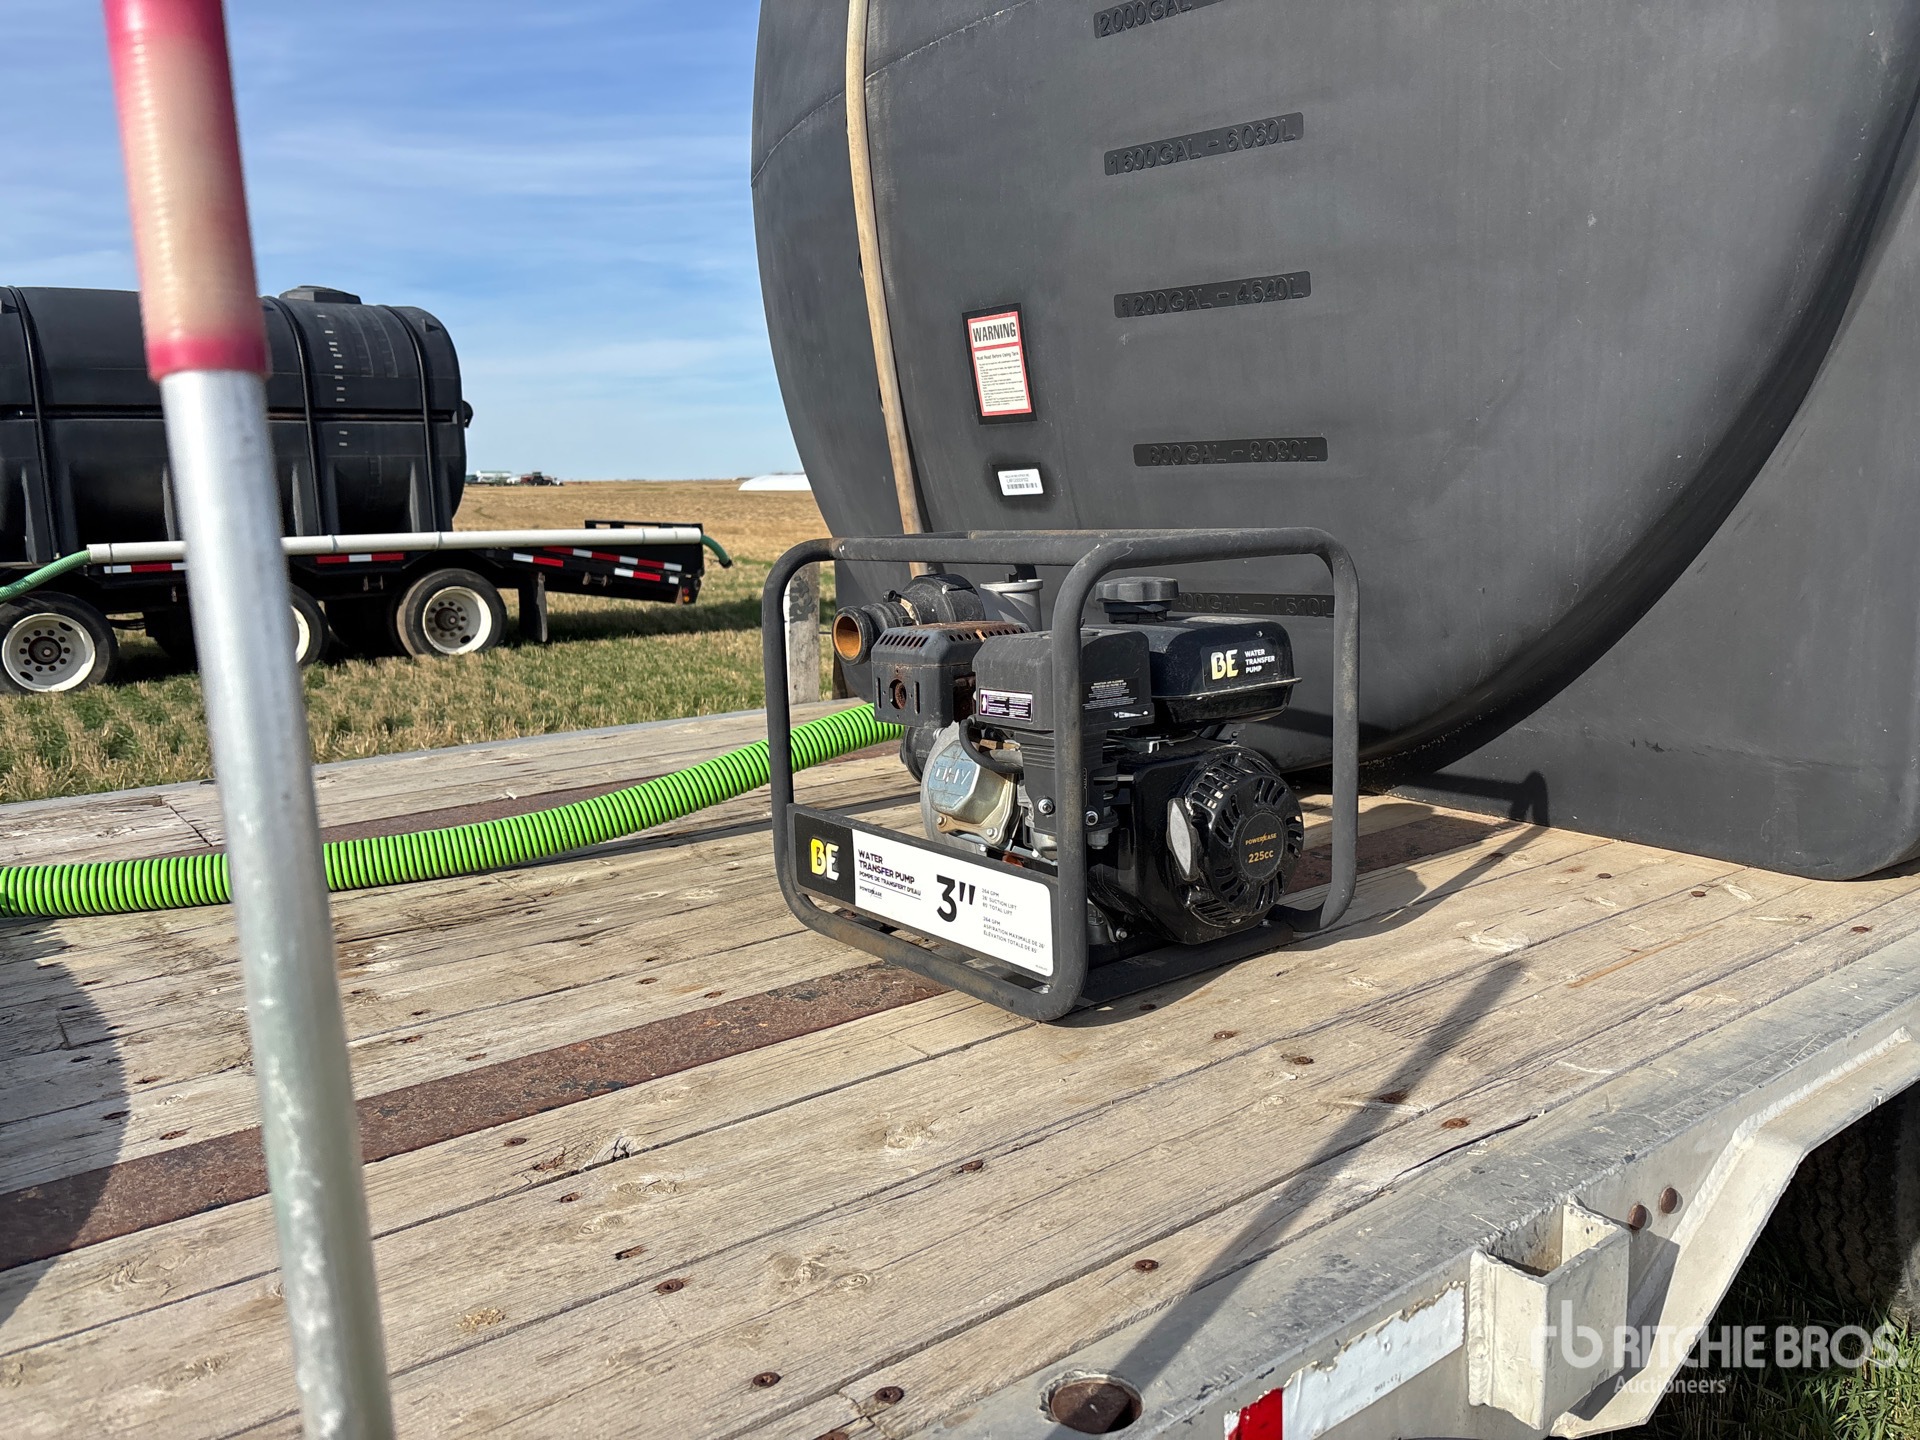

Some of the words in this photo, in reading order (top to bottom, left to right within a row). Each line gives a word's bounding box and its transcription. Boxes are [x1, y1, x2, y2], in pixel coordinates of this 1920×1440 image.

[1108, 138, 1201, 175] 1600GAL
[1121, 288, 1212, 317] 1200GAL
[1236, 276, 1304, 304] 4540L
[973, 322, 1017, 343] WARNING
[1244, 649, 1266, 658] WATER
[1245, 655, 1276, 666] TRANSFER
[1211, 649, 1239, 680] BE
[1245, 665, 1263, 674] PUMP
[809, 837, 840, 881] BE
[858, 849, 883, 864] WATER
[859, 860, 894, 878] TRANSFER
[895, 871, 915, 884] PUMP
[859, 871, 874, 880] POMPE
[881, 878, 907, 890] TRANSFERT
